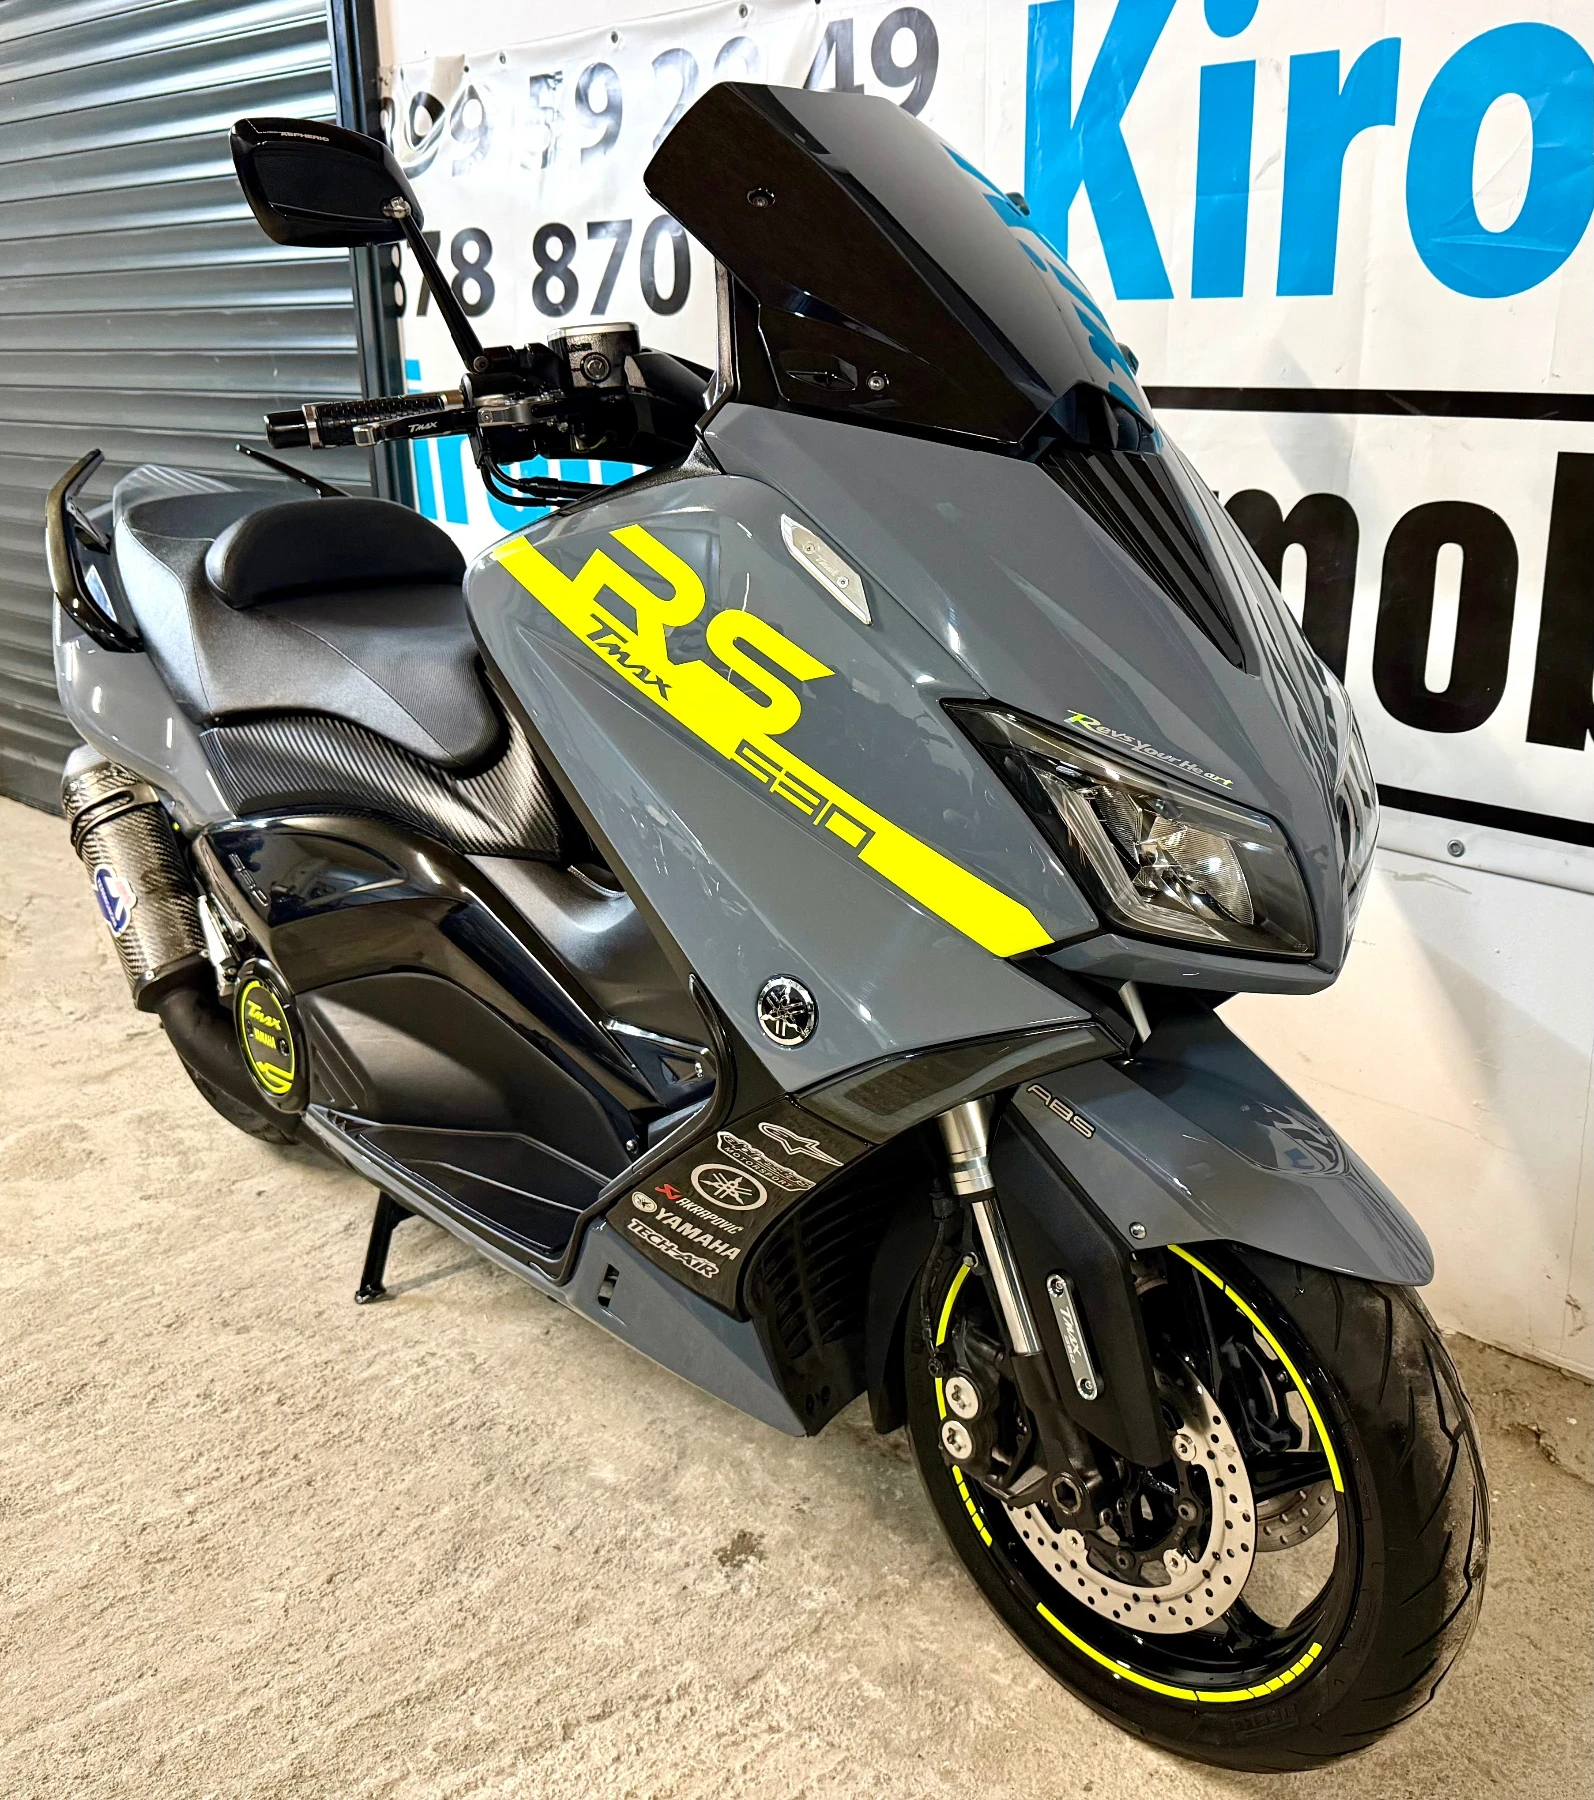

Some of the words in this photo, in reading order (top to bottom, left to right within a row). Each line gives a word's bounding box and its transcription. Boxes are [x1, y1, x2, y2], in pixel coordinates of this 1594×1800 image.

[803, 7, 939, 118] 49
[1024, 0, 1594, 301] Kiro
[531, 214, 691, 318] 870
[571, 523, 836, 735] RS
[1026, 1083, 1095, 1139] ABS
[724, 1147, 793, 1187] MOTORSPORT
[655, 1207, 741, 1261] YAMAHA
